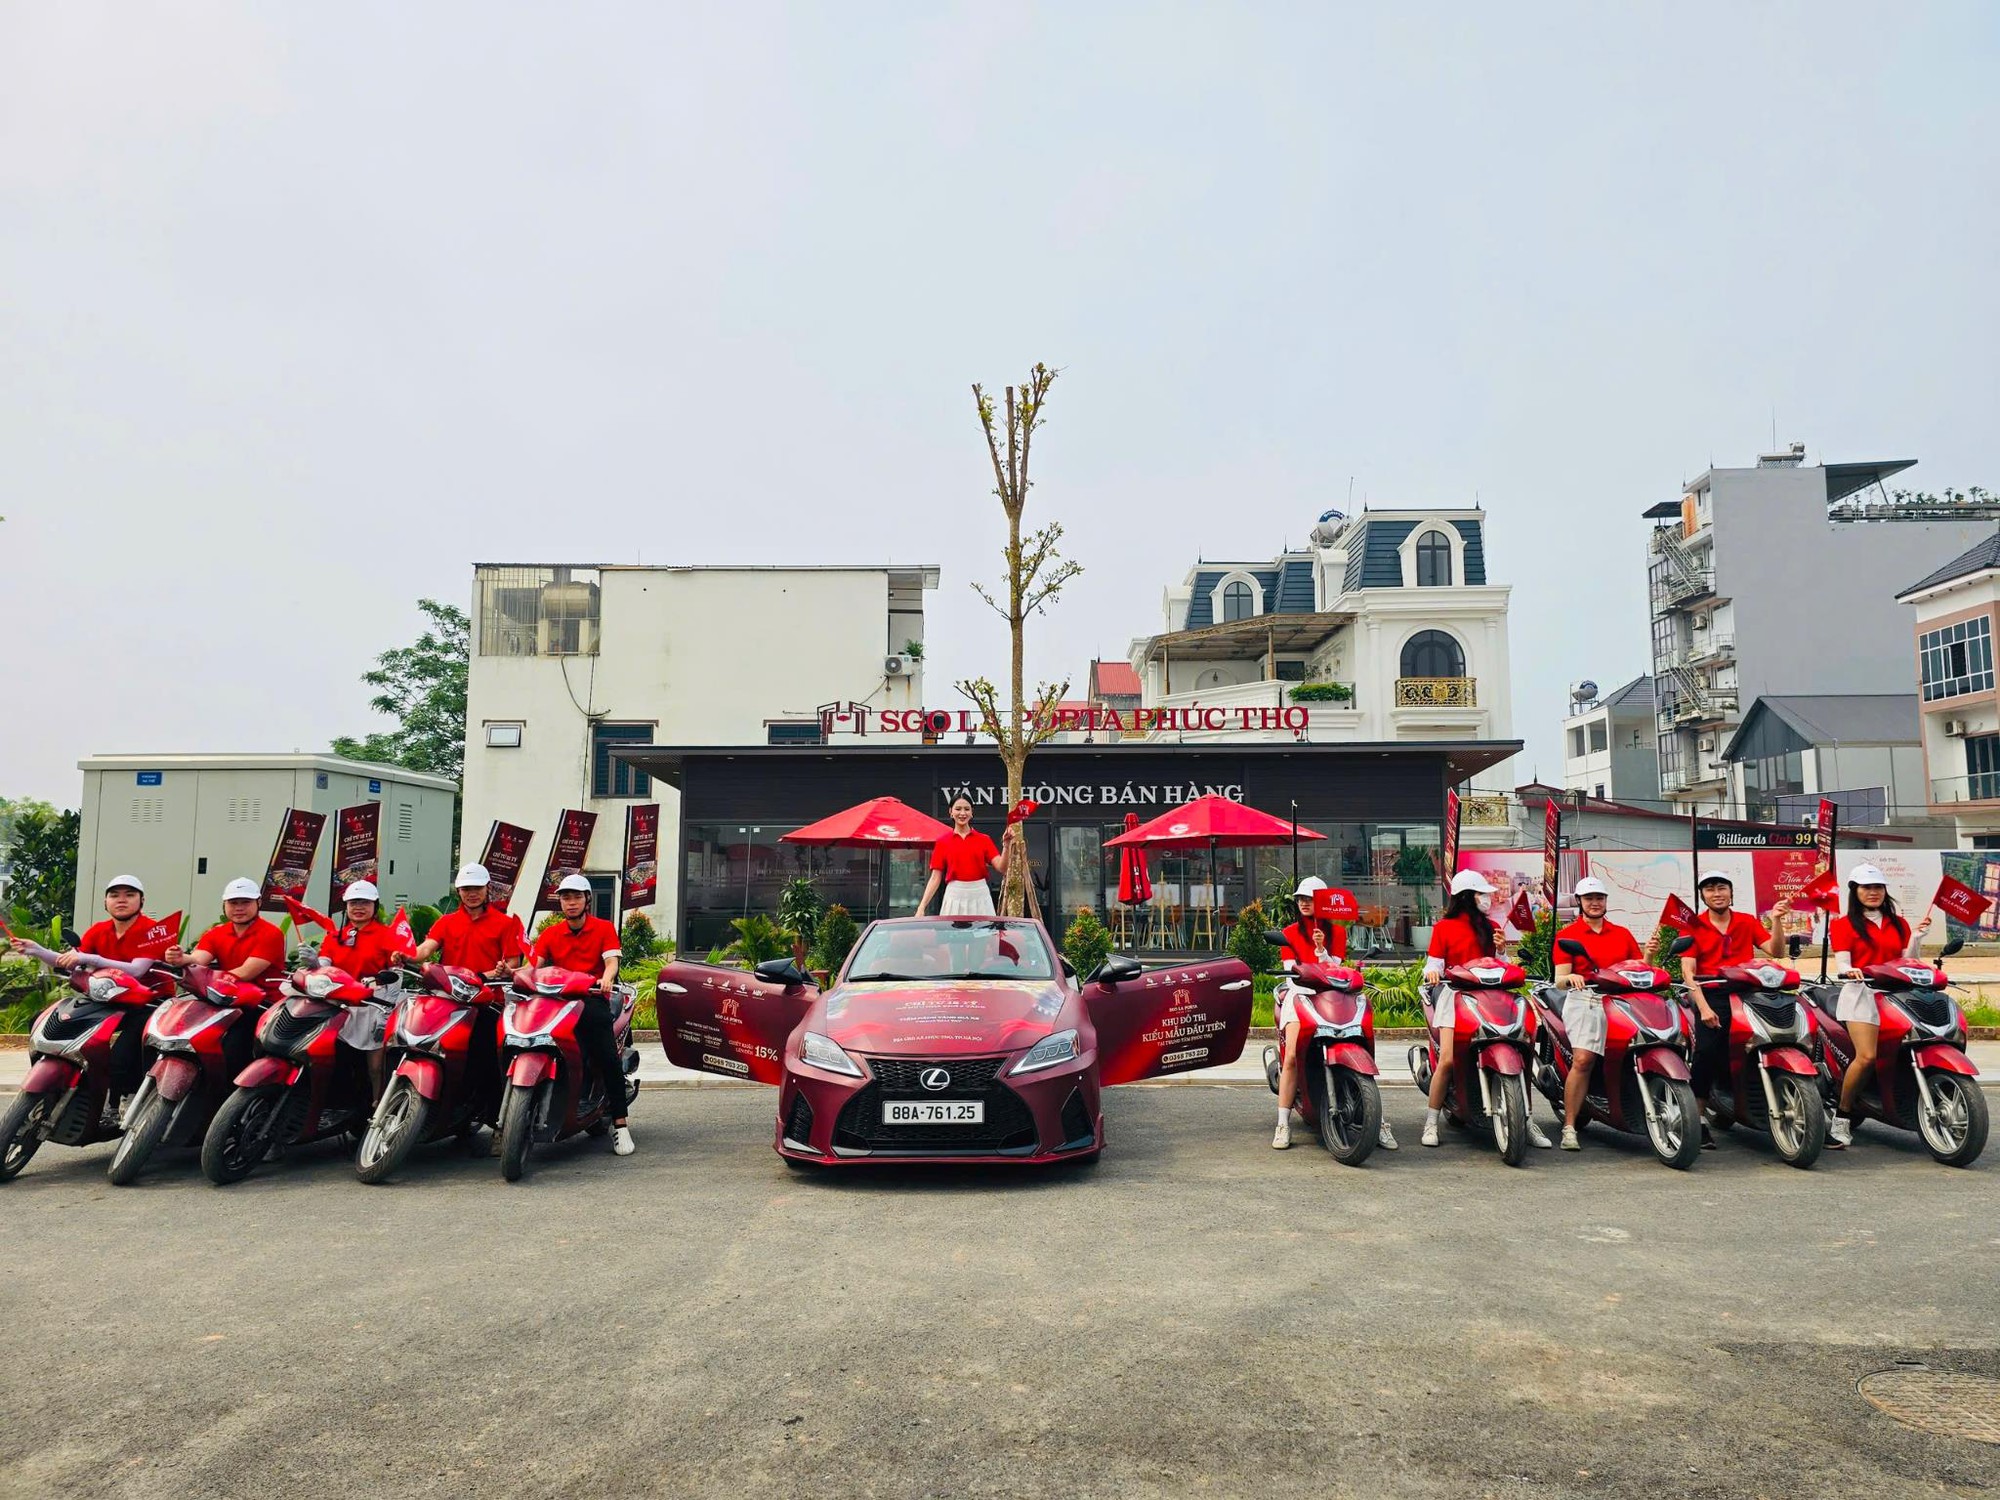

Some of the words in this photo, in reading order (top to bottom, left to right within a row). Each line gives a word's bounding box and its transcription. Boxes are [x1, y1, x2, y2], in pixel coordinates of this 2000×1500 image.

[880, 709, 951, 733] SGO
[1134, 701, 1226, 731] PHÚC
[1235, 706, 1310, 738] THỌ
[941, 781, 994, 805] VĂN
[1100, 781, 1158, 804] BÁN
[1163, 781, 1244, 804] HÀNG
[1716, 833, 1766, 845] Billiards
[1769, 833, 1792, 845] Club
[1795, 833, 1812, 845] 99
[1162, 1017, 1179, 1027] KHU
[1180, 1014, 1192, 1025] ĐÔ
[1193, 1013, 1206, 1022] THỊ
[1206, 1021, 1226, 1032] TIÊN
[755, 1045, 778, 1061] 15%
[892, 1106, 976, 1120] 88A-761.25
